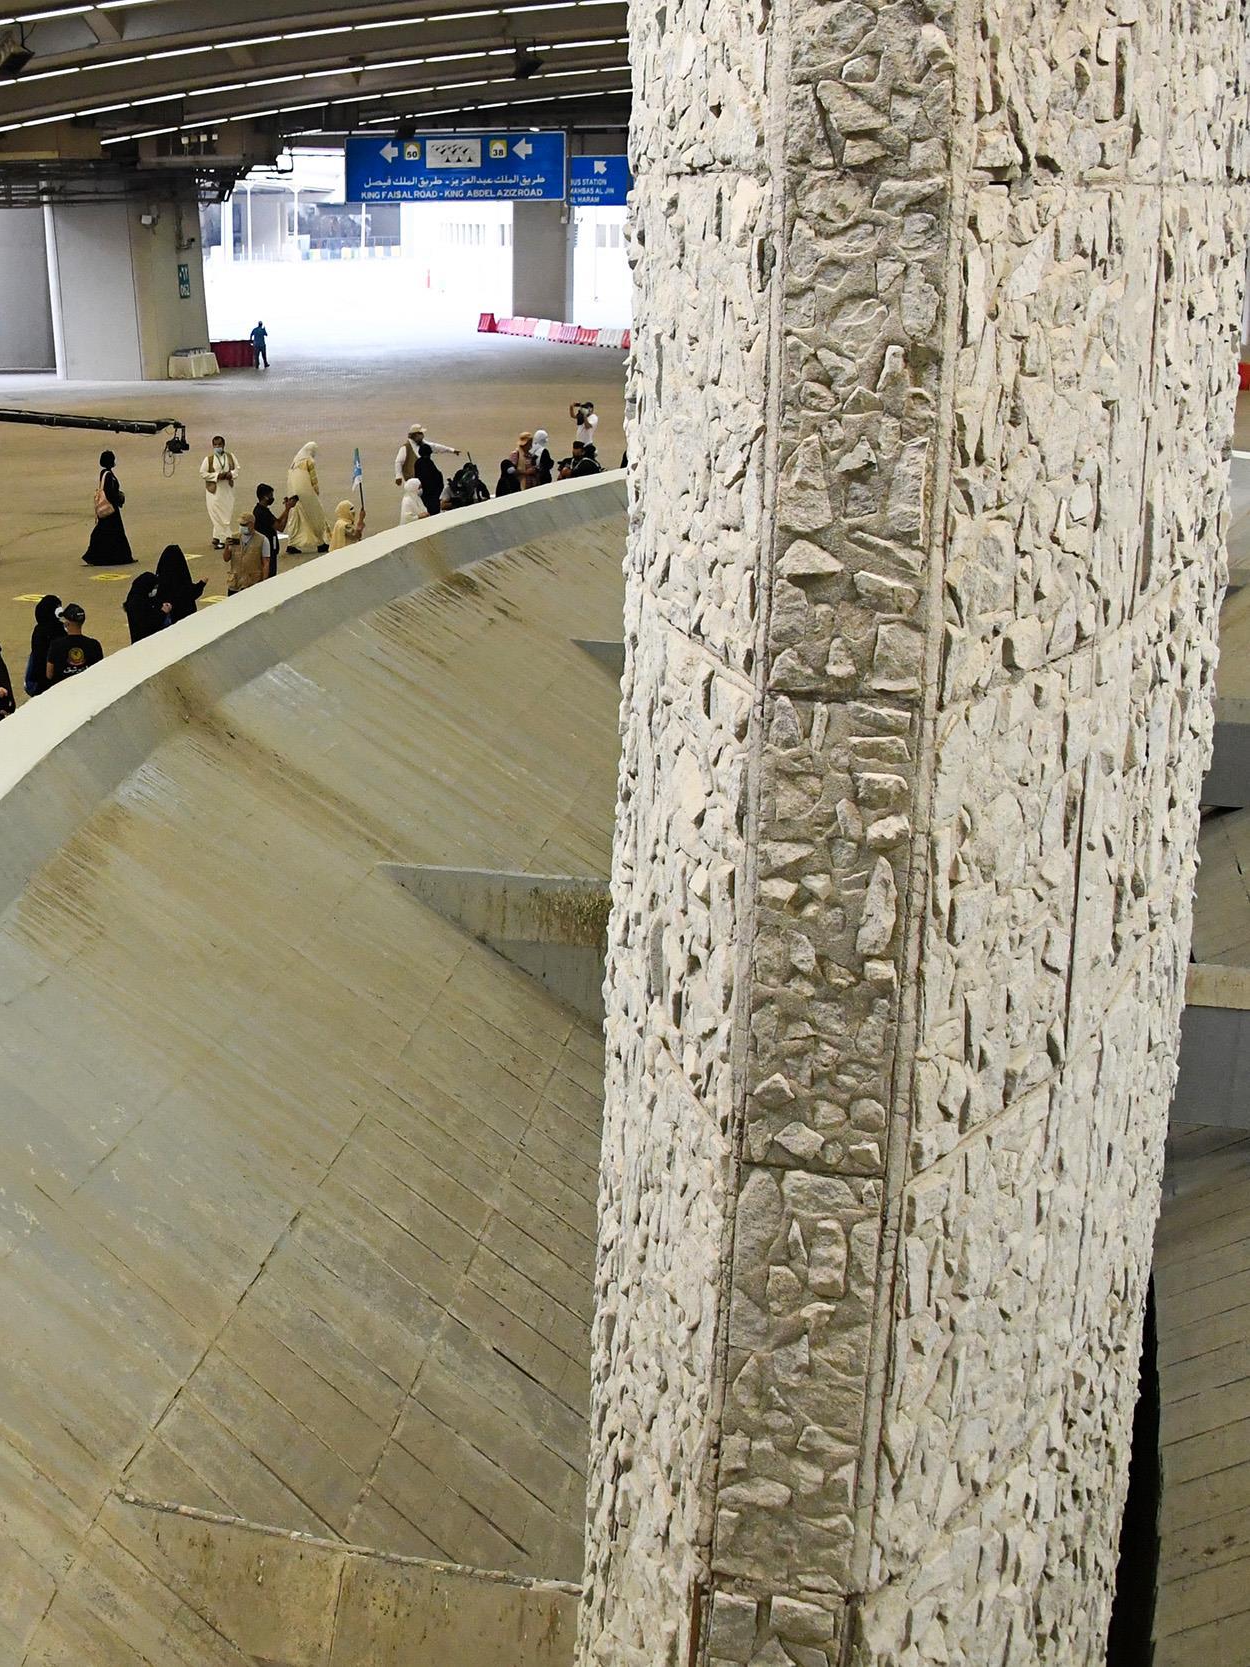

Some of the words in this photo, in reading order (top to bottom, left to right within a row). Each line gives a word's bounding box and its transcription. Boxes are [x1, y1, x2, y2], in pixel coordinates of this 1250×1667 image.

[493, 149, 504, 157] 38
[364, 176, 391, 188] فيصل
[393, 176, 417, 186] الملك
[418, 176, 442, 188] طريق
[494, 175, 519, 184] الملك
[520, 174, 546, 186] طريق
[582, 178, 607, 186] STATION
[361, 191, 380, 199] KING
[381, 191, 413, 199] FAISAL
[414, 190, 438, 199] ROAD
[444, 190, 464, 198] KING
[466, 189, 495, 197] ABDEL
